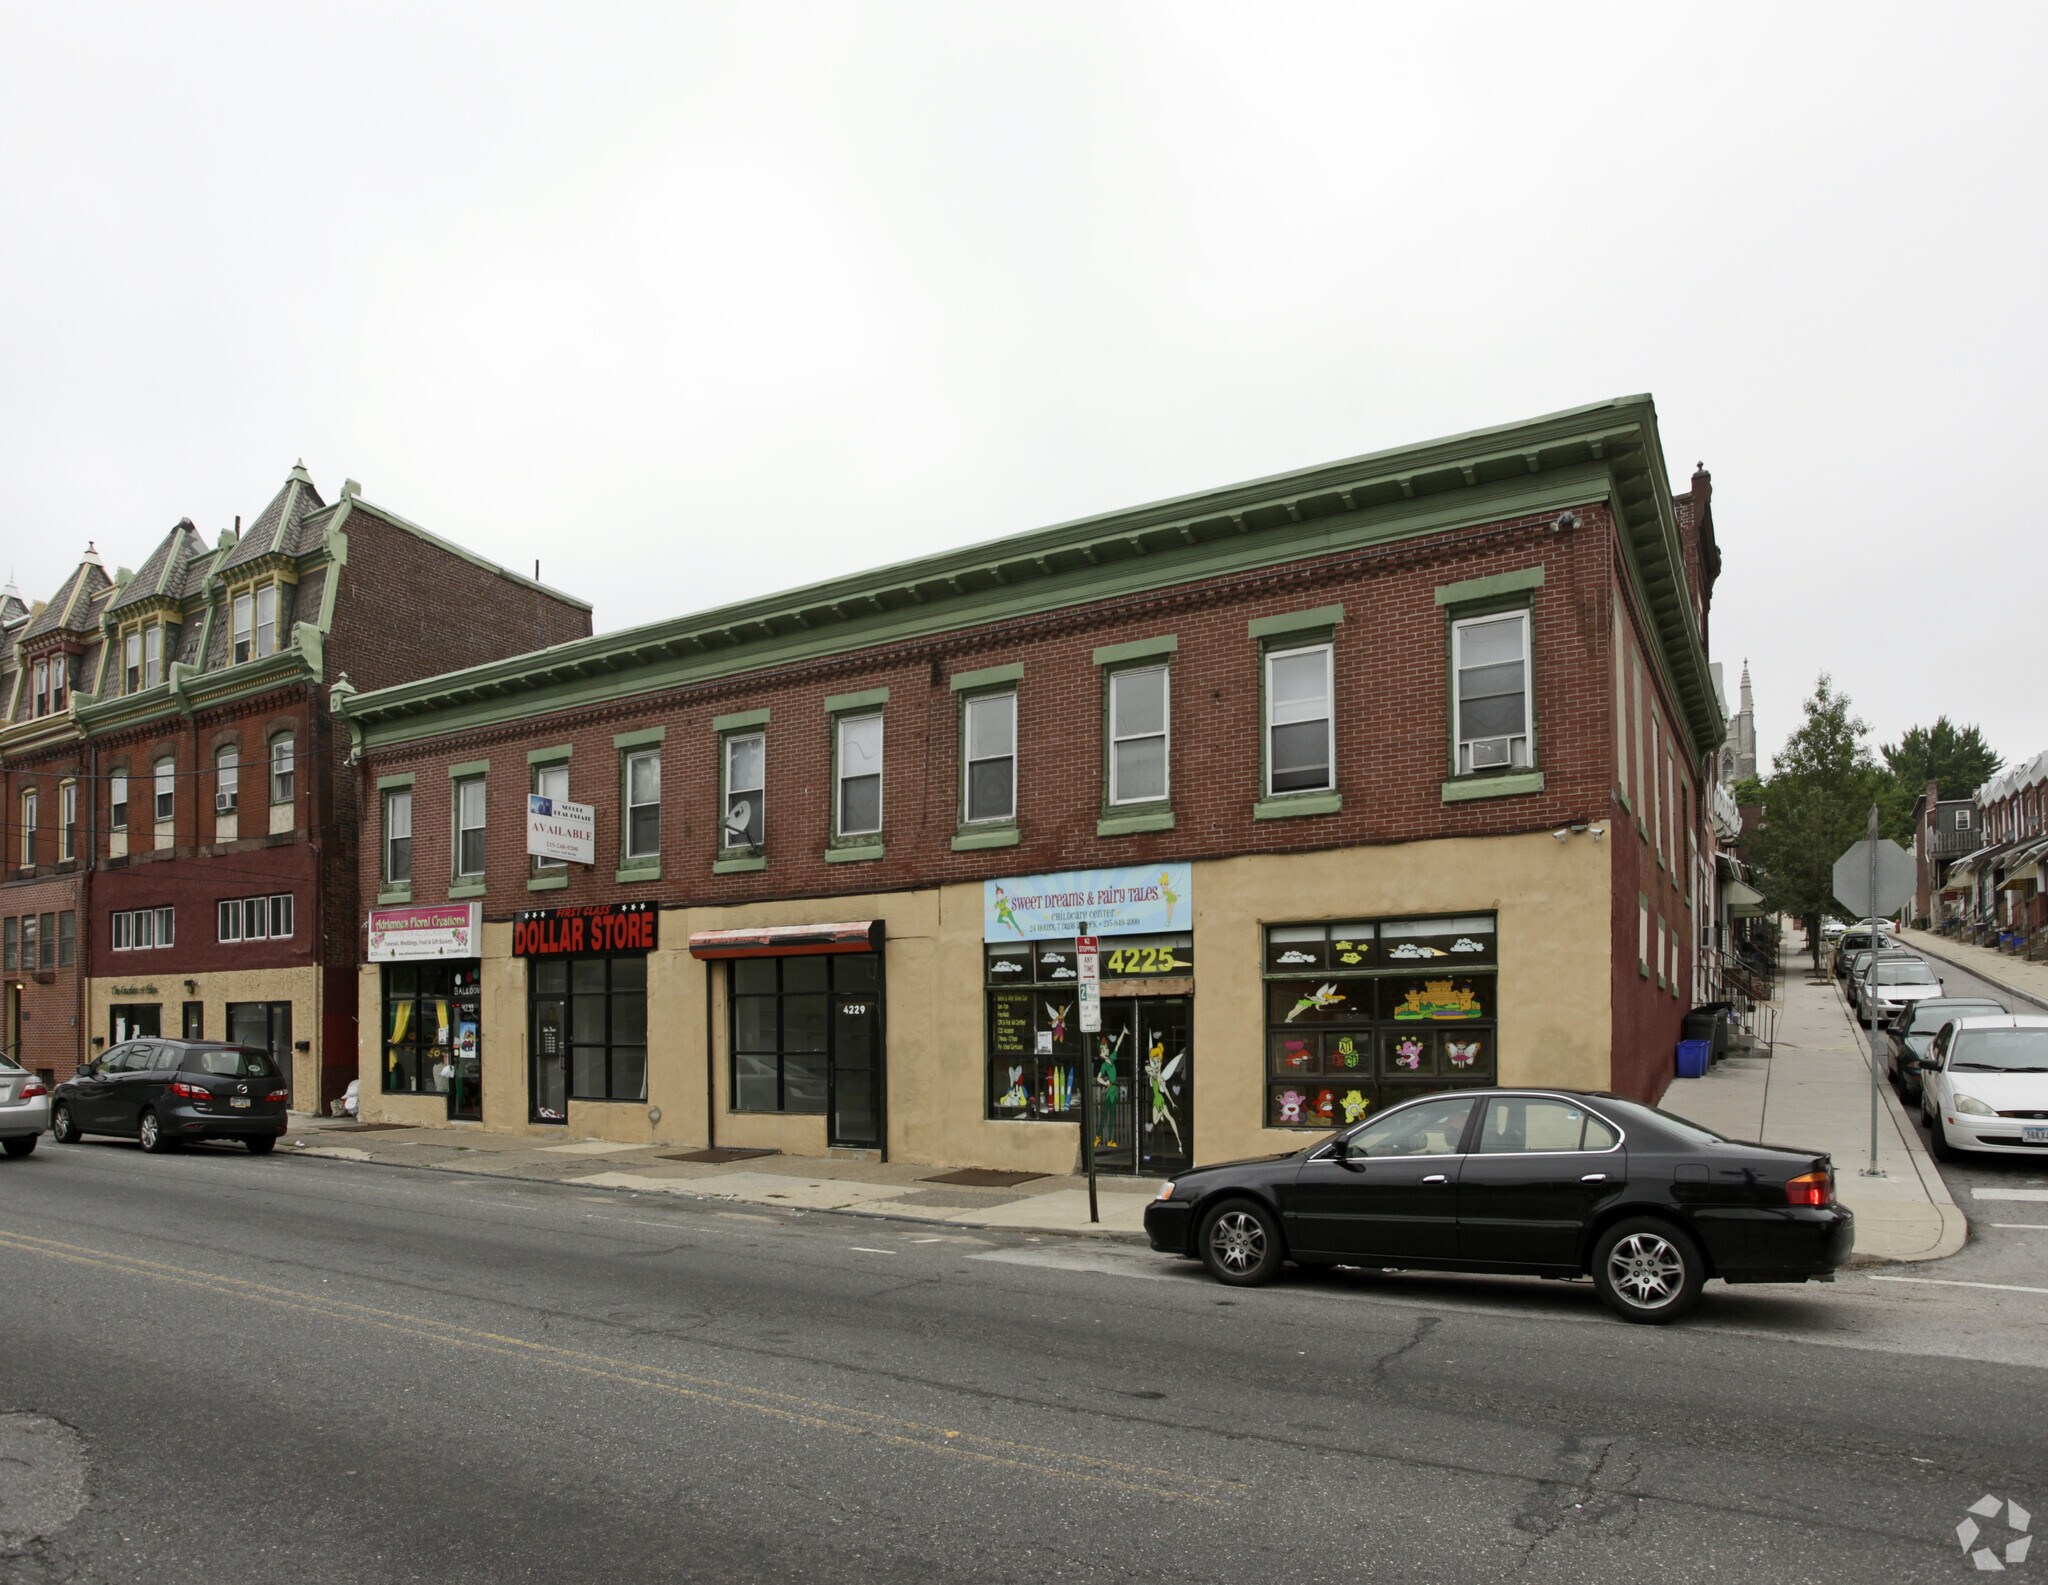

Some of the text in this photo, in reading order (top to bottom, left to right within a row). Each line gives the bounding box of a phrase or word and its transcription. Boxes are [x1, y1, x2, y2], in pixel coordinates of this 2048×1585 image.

[531, 822, 593, 841] AVAILABLE
[1087, 891, 1095, 904] &
[556, 905, 611, 918] FIRST CLASS
[410, 916, 431, 928] Floral
[432, 915, 465, 927] Creations
[515, 912, 654, 955] DOLLAR STORE
[1078, 945, 1097, 953] STOPPING
[1108, 946, 1175, 974] 4225
[1083, 964, 1094, 973] TIME
[1080, 986, 1086, 999] 2
[843, 1005, 866, 1015] 4229
